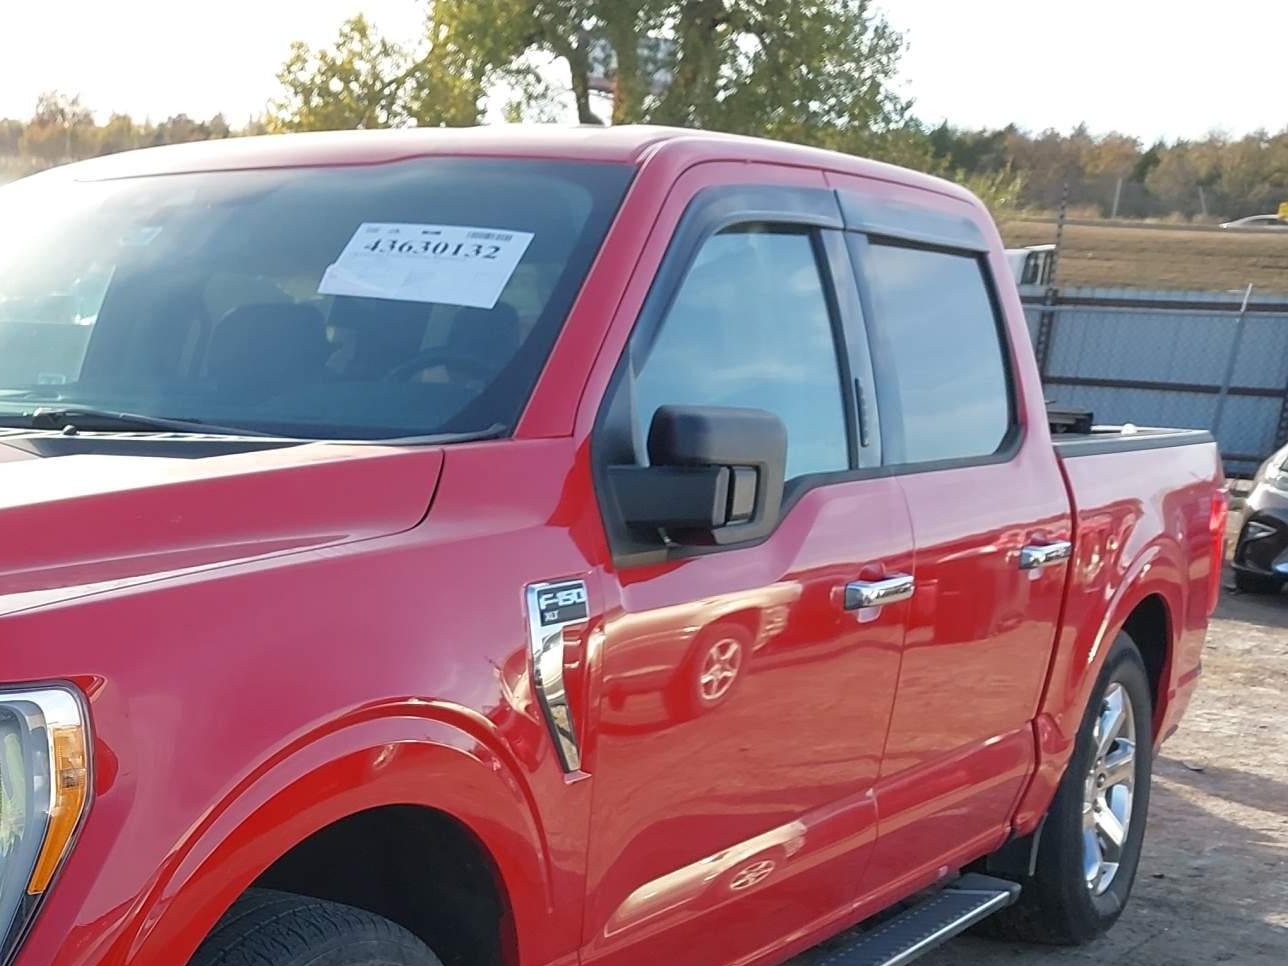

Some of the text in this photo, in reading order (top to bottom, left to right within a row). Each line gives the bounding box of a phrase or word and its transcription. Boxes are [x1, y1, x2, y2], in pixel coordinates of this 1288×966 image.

[364, 238, 501, 260] 43630132
[540, 588, 587, 610] F-150
[543, 610, 559, 622] XLT
